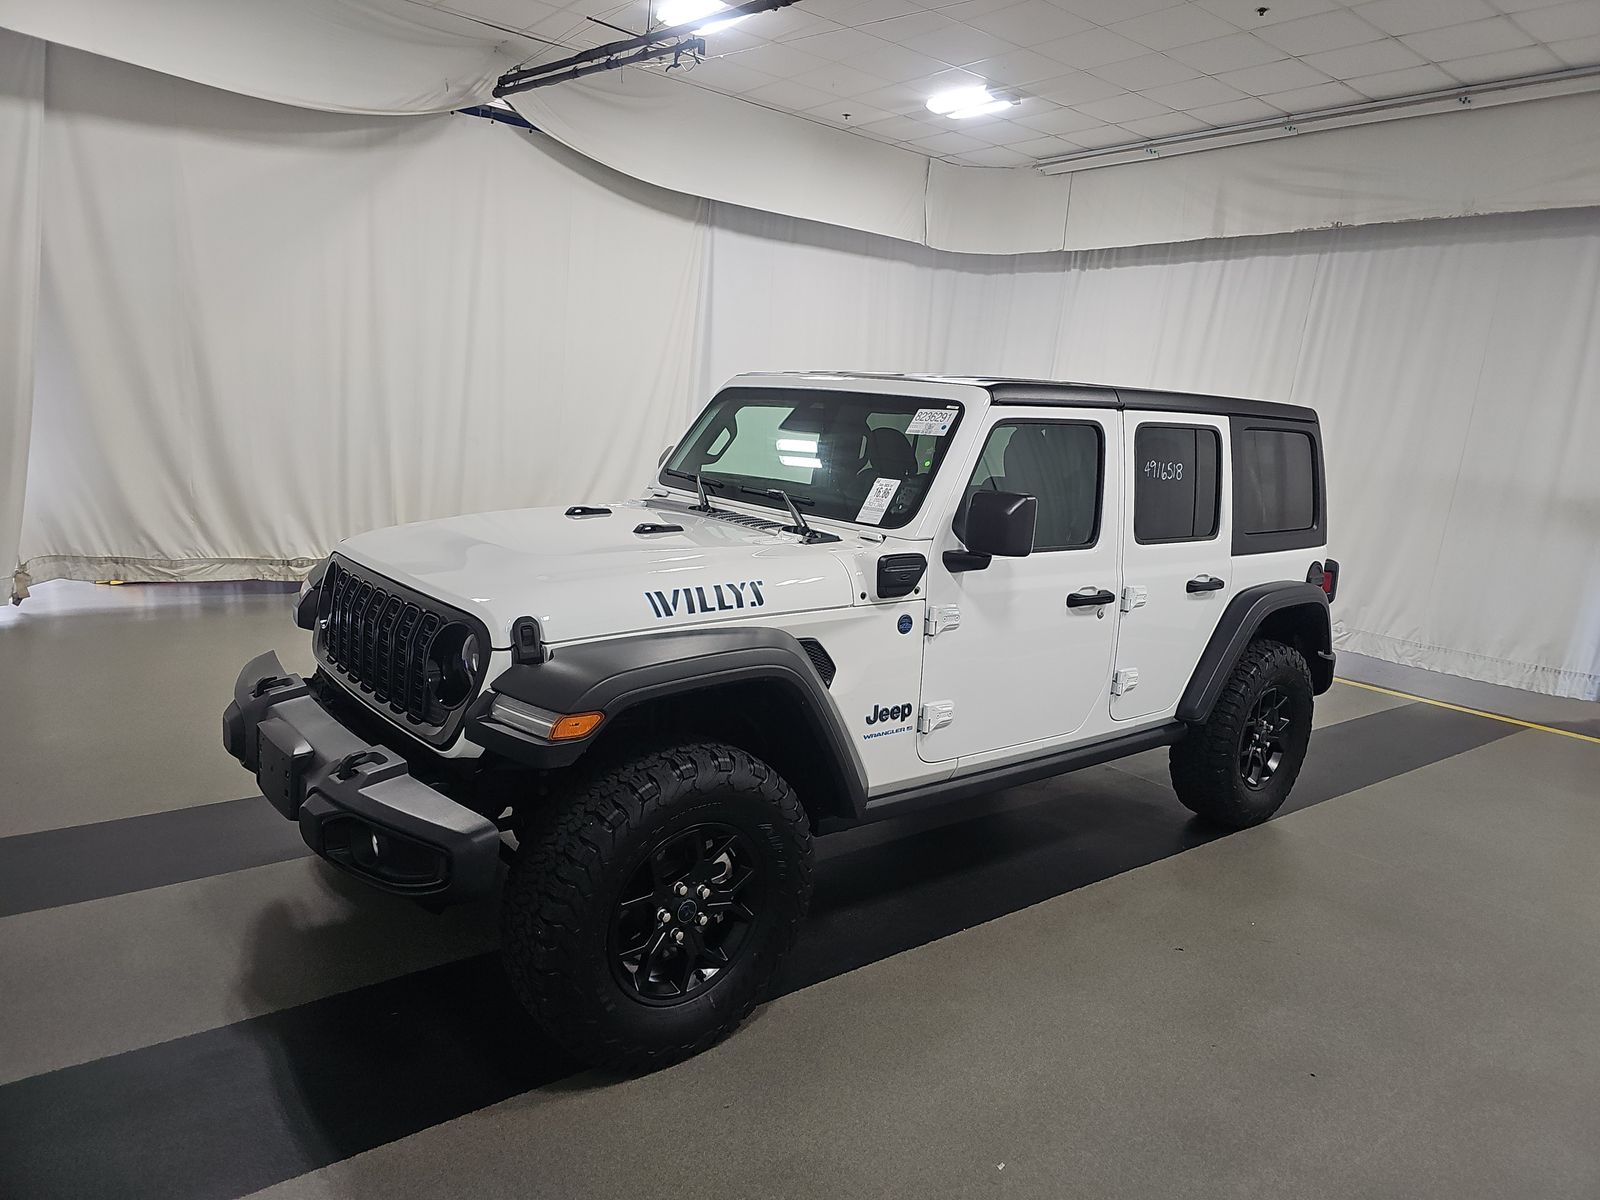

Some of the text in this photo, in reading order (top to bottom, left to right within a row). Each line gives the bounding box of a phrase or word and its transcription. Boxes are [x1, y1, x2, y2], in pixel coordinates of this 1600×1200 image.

[915, 411, 952, 422] 8236291
[1144, 460, 1183, 480] 4916518
[644, 580, 765, 618] WILLYS
[865, 703, 912, 725] Jeep
[863, 727, 906, 740] WRANGLER
